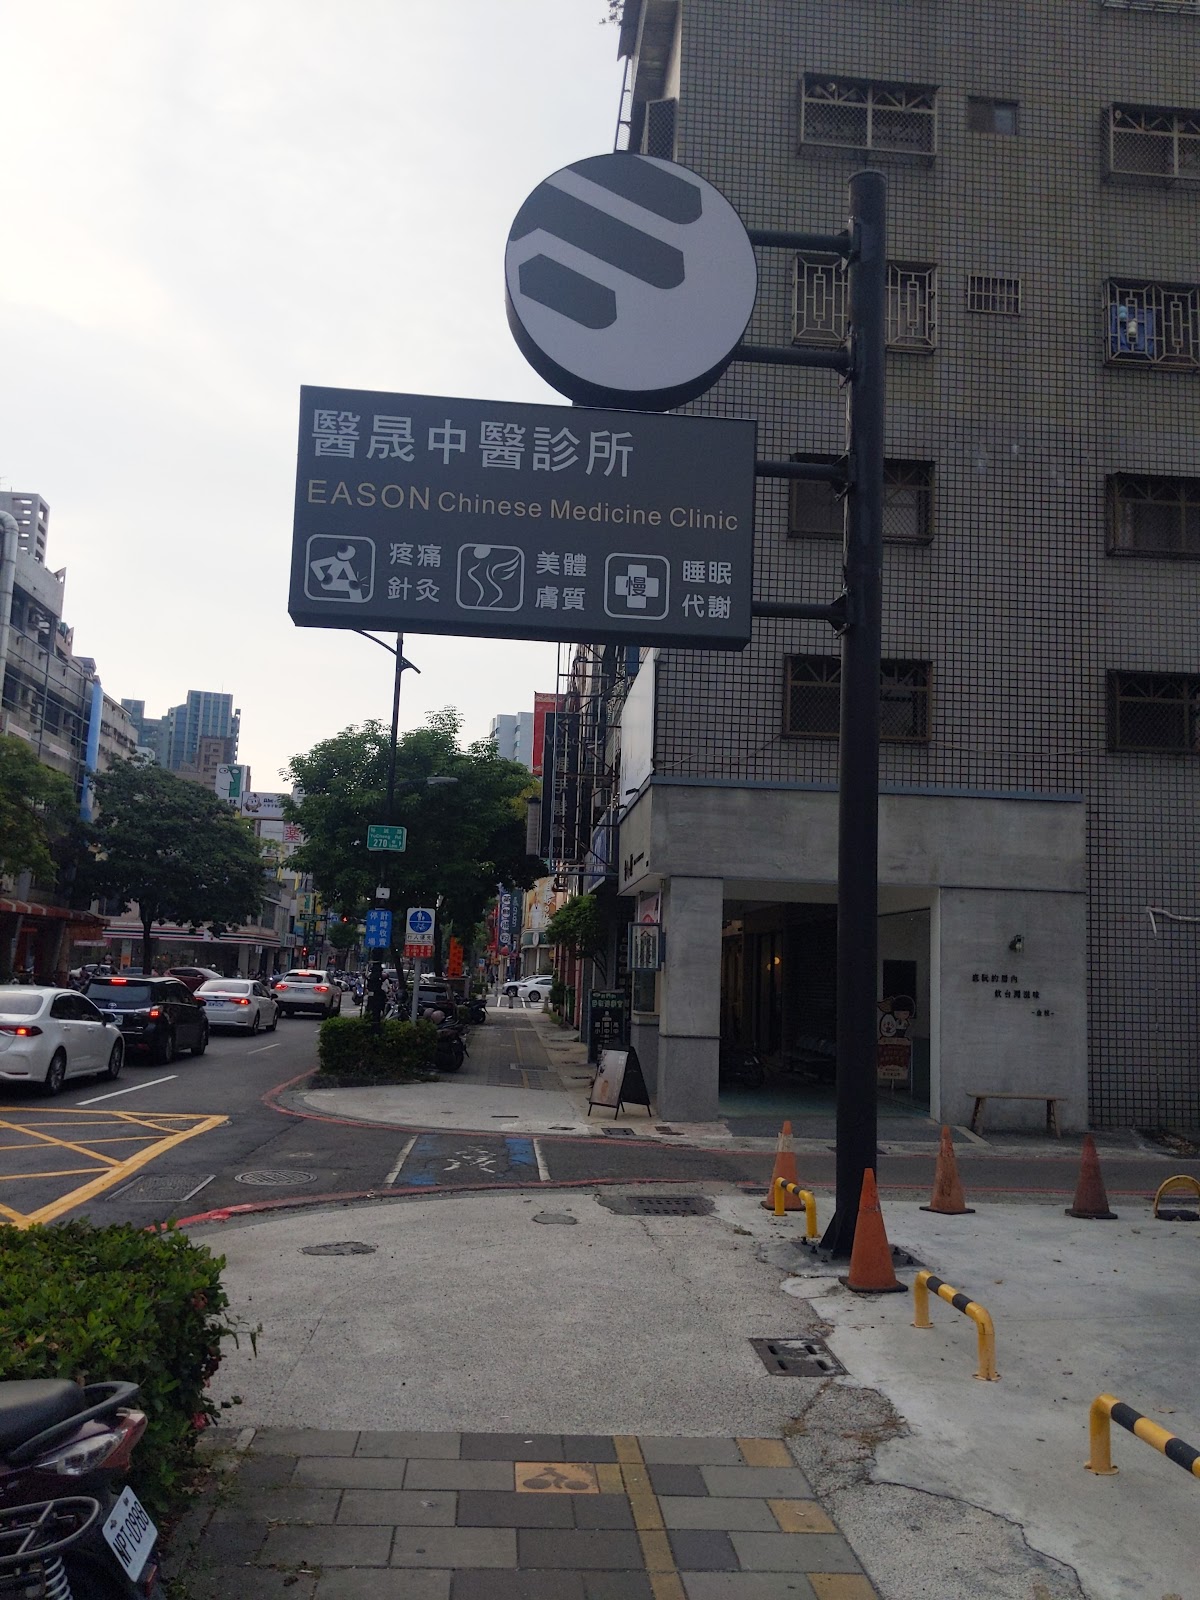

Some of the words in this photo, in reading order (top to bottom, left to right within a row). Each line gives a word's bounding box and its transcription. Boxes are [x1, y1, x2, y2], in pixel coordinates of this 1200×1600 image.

[312, 409, 634, 477] 醫晟中醫診所
[307, 479, 430, 511] EASON
[437, 491, 542, 518] Chinese
[550, 499, 662, 526] Medicine
[669, 507, 738, 531] Clinic
[389, 542, 442, 568] 疼痛
[536, 551, 587, 577] 美體
[682, 560, 732, 585] 睡眠
[387, 576, 440, 602] 針灸
[535, 585, 586, 611] 膚質
[625, 575, 646, 597] 慢
[681, 593, 732, 619] 代謝
[373, 838, 388, 848] 270
[368, 911, 378, 946] 停車場
[379, 911, 389, 946] 計時收費
[112, 1501, 150, 1568] NPT-0988
